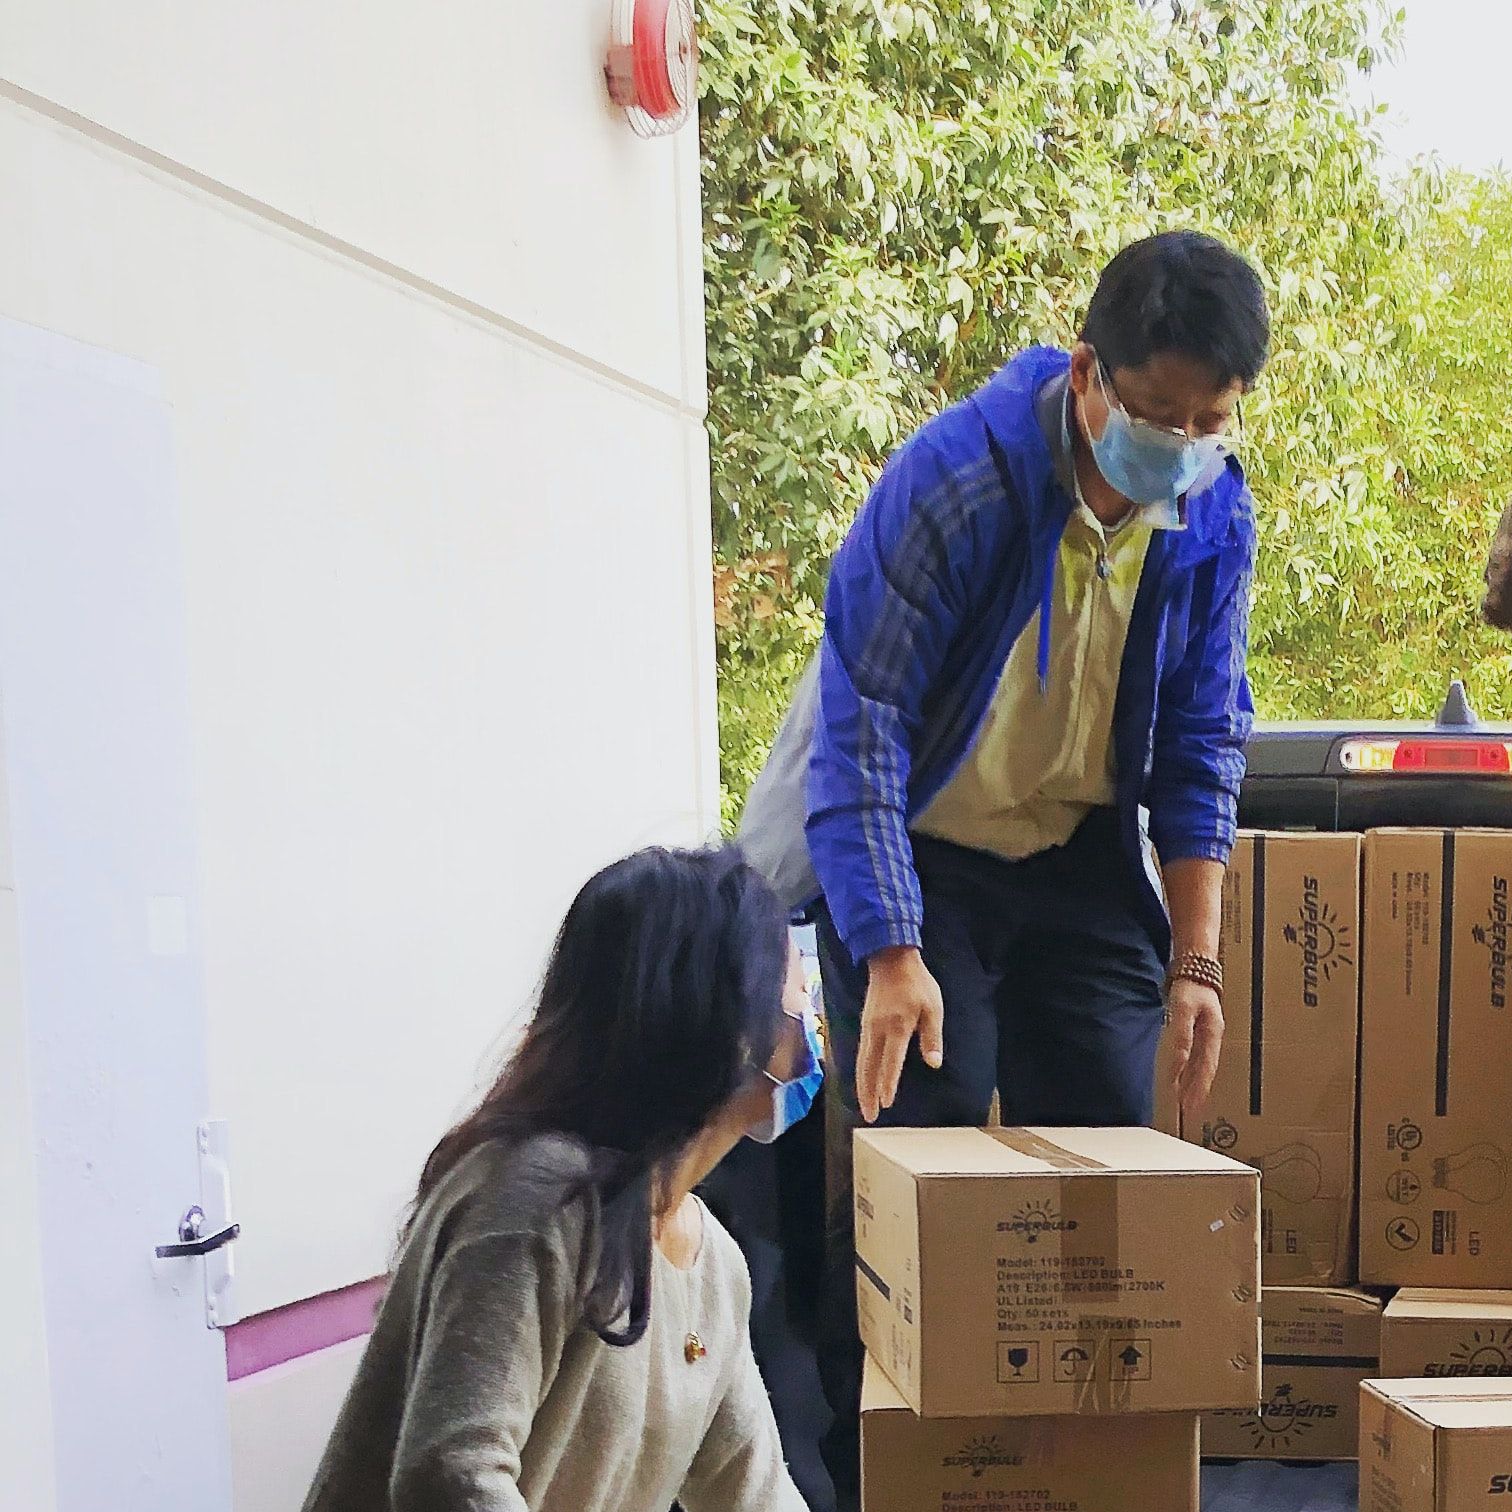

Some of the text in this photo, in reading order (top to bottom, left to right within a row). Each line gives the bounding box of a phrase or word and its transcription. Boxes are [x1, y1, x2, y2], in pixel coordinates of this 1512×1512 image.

[1303, 875, 1319, 1008] SUPERBULB
[1490, 875, 1508, 1009] SUPERBULB
[1286, 1229, 1296, 1254] LED
[1469, 1230, 1480, 1256] LED
